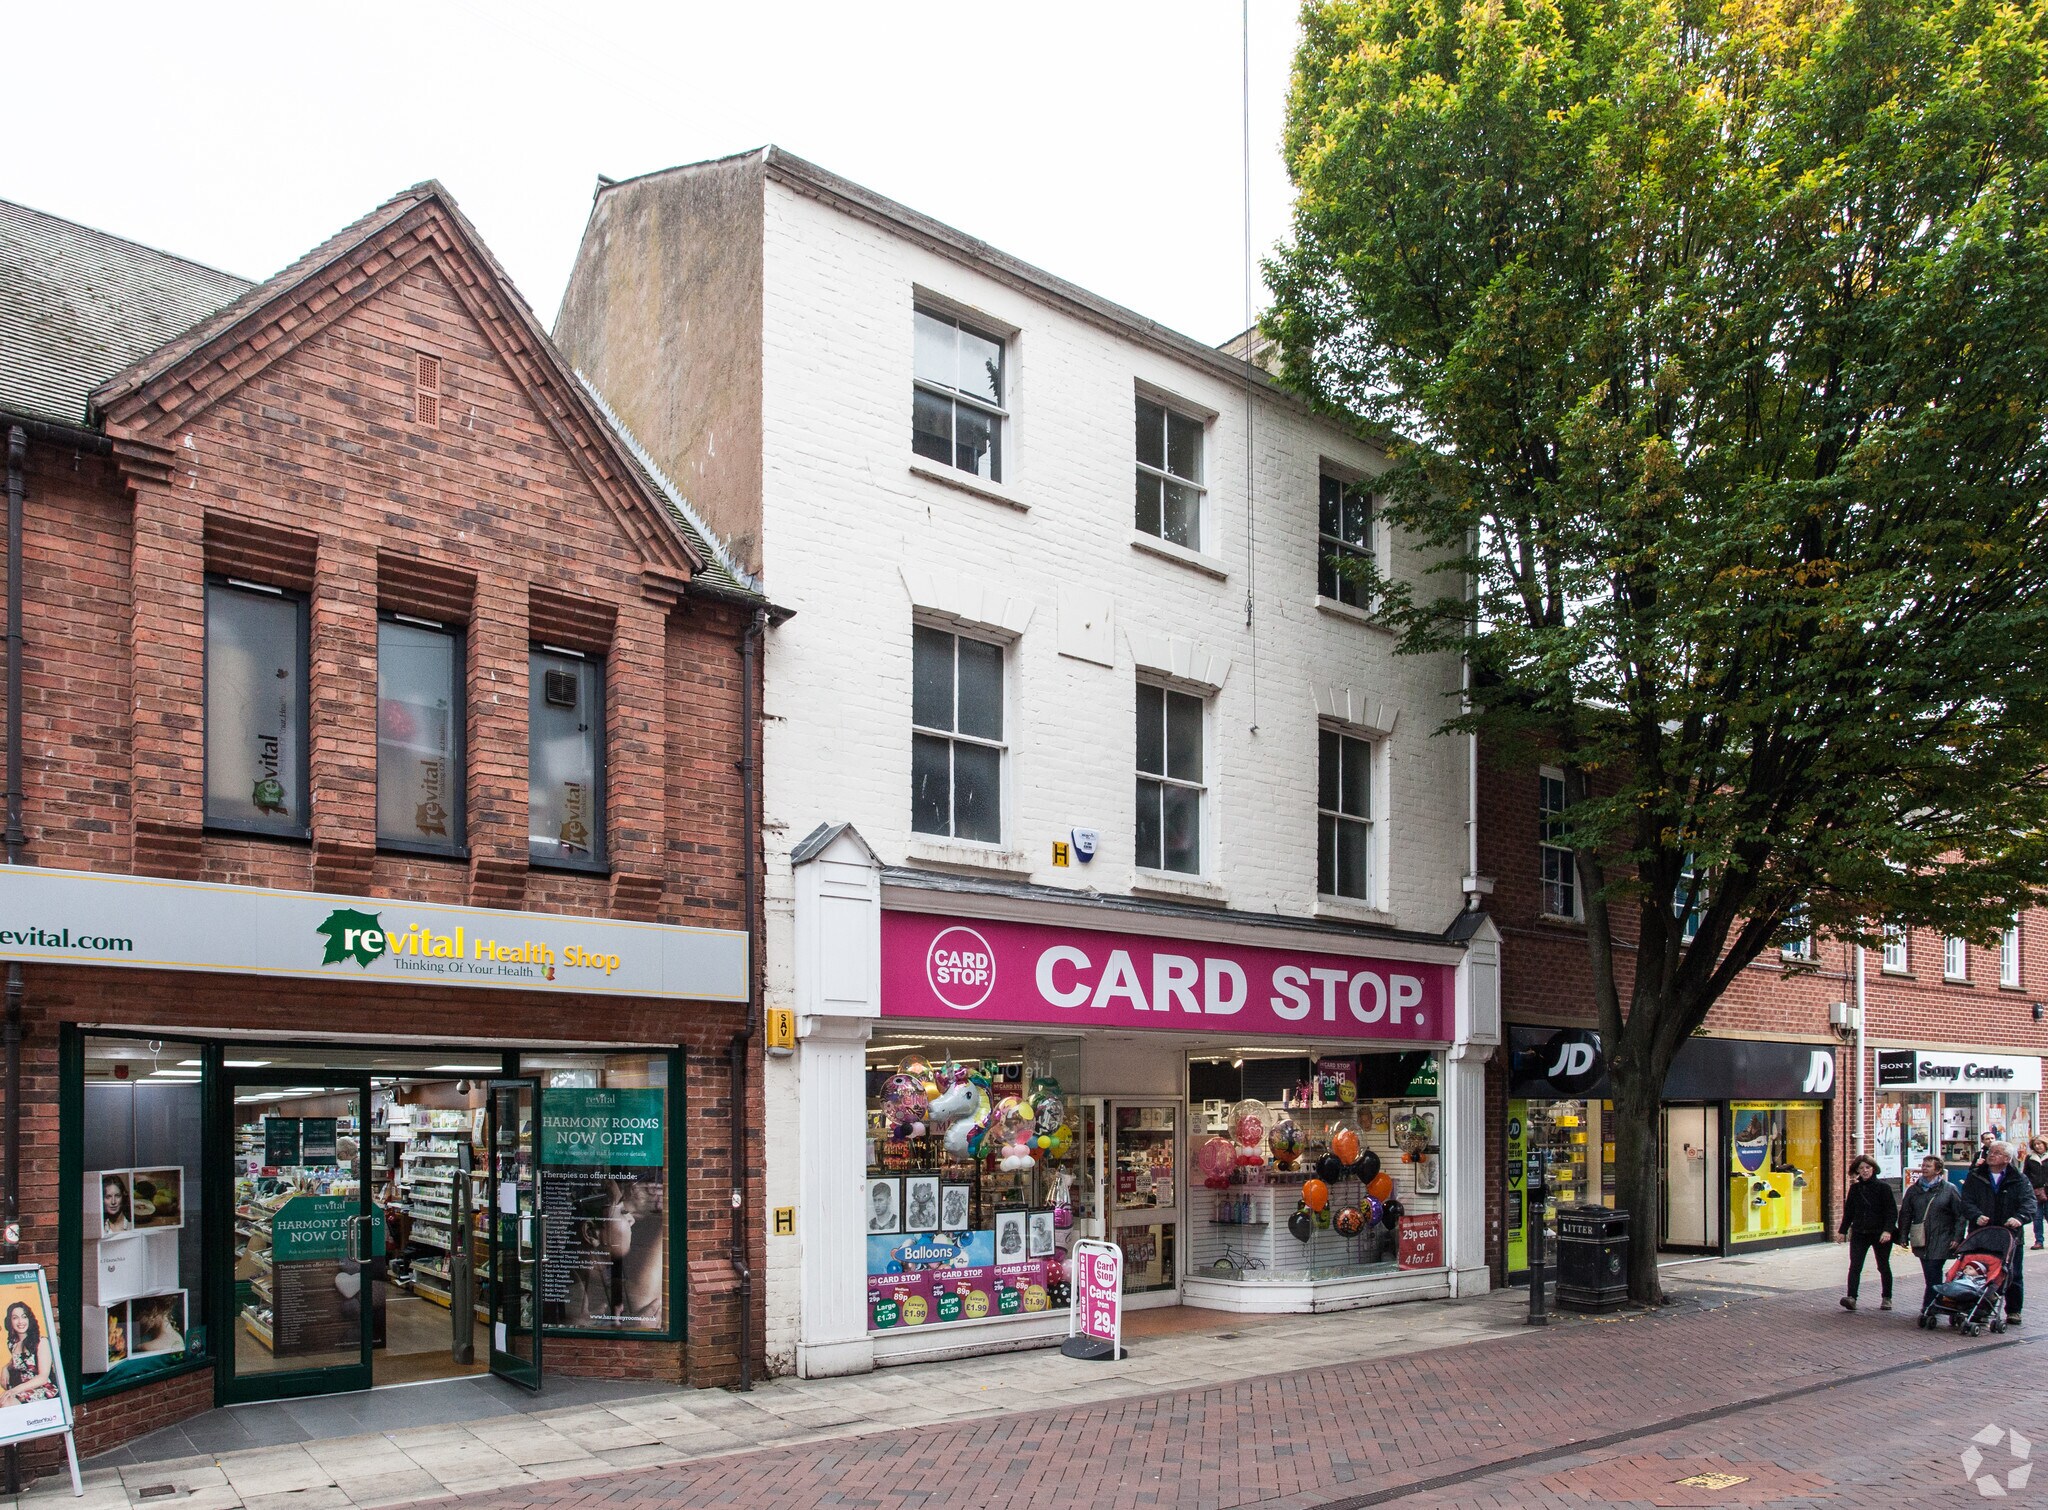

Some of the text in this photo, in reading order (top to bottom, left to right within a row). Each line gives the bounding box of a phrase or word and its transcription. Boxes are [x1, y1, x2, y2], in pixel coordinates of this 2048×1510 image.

[258, 734, 279, 803] revital
[420, 760, 439, 824] revital
[1054, 843, 1068, 865] H
[343, 922, 621, 976] revital Health Shop
[934, 949, 989, 969] CARD
[393, 957, 534, 978] Thinking Of Your Health
[1035, 945, 1248, 1015] CARD
[780, 1013, 788, 1037] SAV
[1547, 1042, 1595, 1077] JD
[1802, 1050, 1834, 1093] JD
[1880, 1060, 2014, 1081] SONY Sony Centre
[585, 1093, 616, 1104] revital
[542, 1116, 660, 1129] HARMONY ROOMS
[556, 1131, 644, 1146] NOW OPEN
[542, 1170, 578, 1180] Therapies
[589, 1171, 608, 1180] offer
[608, 1172, 638, 1180] include:
[314, 1200, 346, 1211] revital
[277, 1219, 338, 1230] HARMONY
[776, 1209, 793, 1233] H
[1402, 1226, 1438, 1242] 29p each
[1562, 1223, 1594, 1235] LITTER
[290, 1230, 327, 1243] NOW
[904, 1245, 953, 1260] Balloons
[1416, 1243, 1426, 1252] or
[1404, 1252, 1434, 1265] 4 for £1
[1002, 1266, 1021, 1274] CARD
[1096, 1260, 1115, 1272] Card
[877, 1276, 900, 1285] CARD
[941, 1271, 963, 1279] CARD
[1096, 1271, 1114, 1282] Stop
[956, 1288, 971, 1296] 89p
[1015, 1282, 1029, 1291] 89p
[893, 1293, 909, 1302] 89p
[1000, 1291, 1018, 1299] Large
[1089, 1284, 1117, 1303] Cards
[940, 1297, 959, 1305] Large
[1001, 1300, 1019, 1309] £1.29
[1025, 1298, 1045, 1306] £1.99
[1097, 1300, 1110, 1309] from
[876, 1303, 897, 1312] Large
[940, 1306, 959, 1315] £1.29
[965, 1304, 988, 1312] £1.99
[877, 1313, 897, 1322] £1.29
[904, 1310, 926, 1318] £1.99
